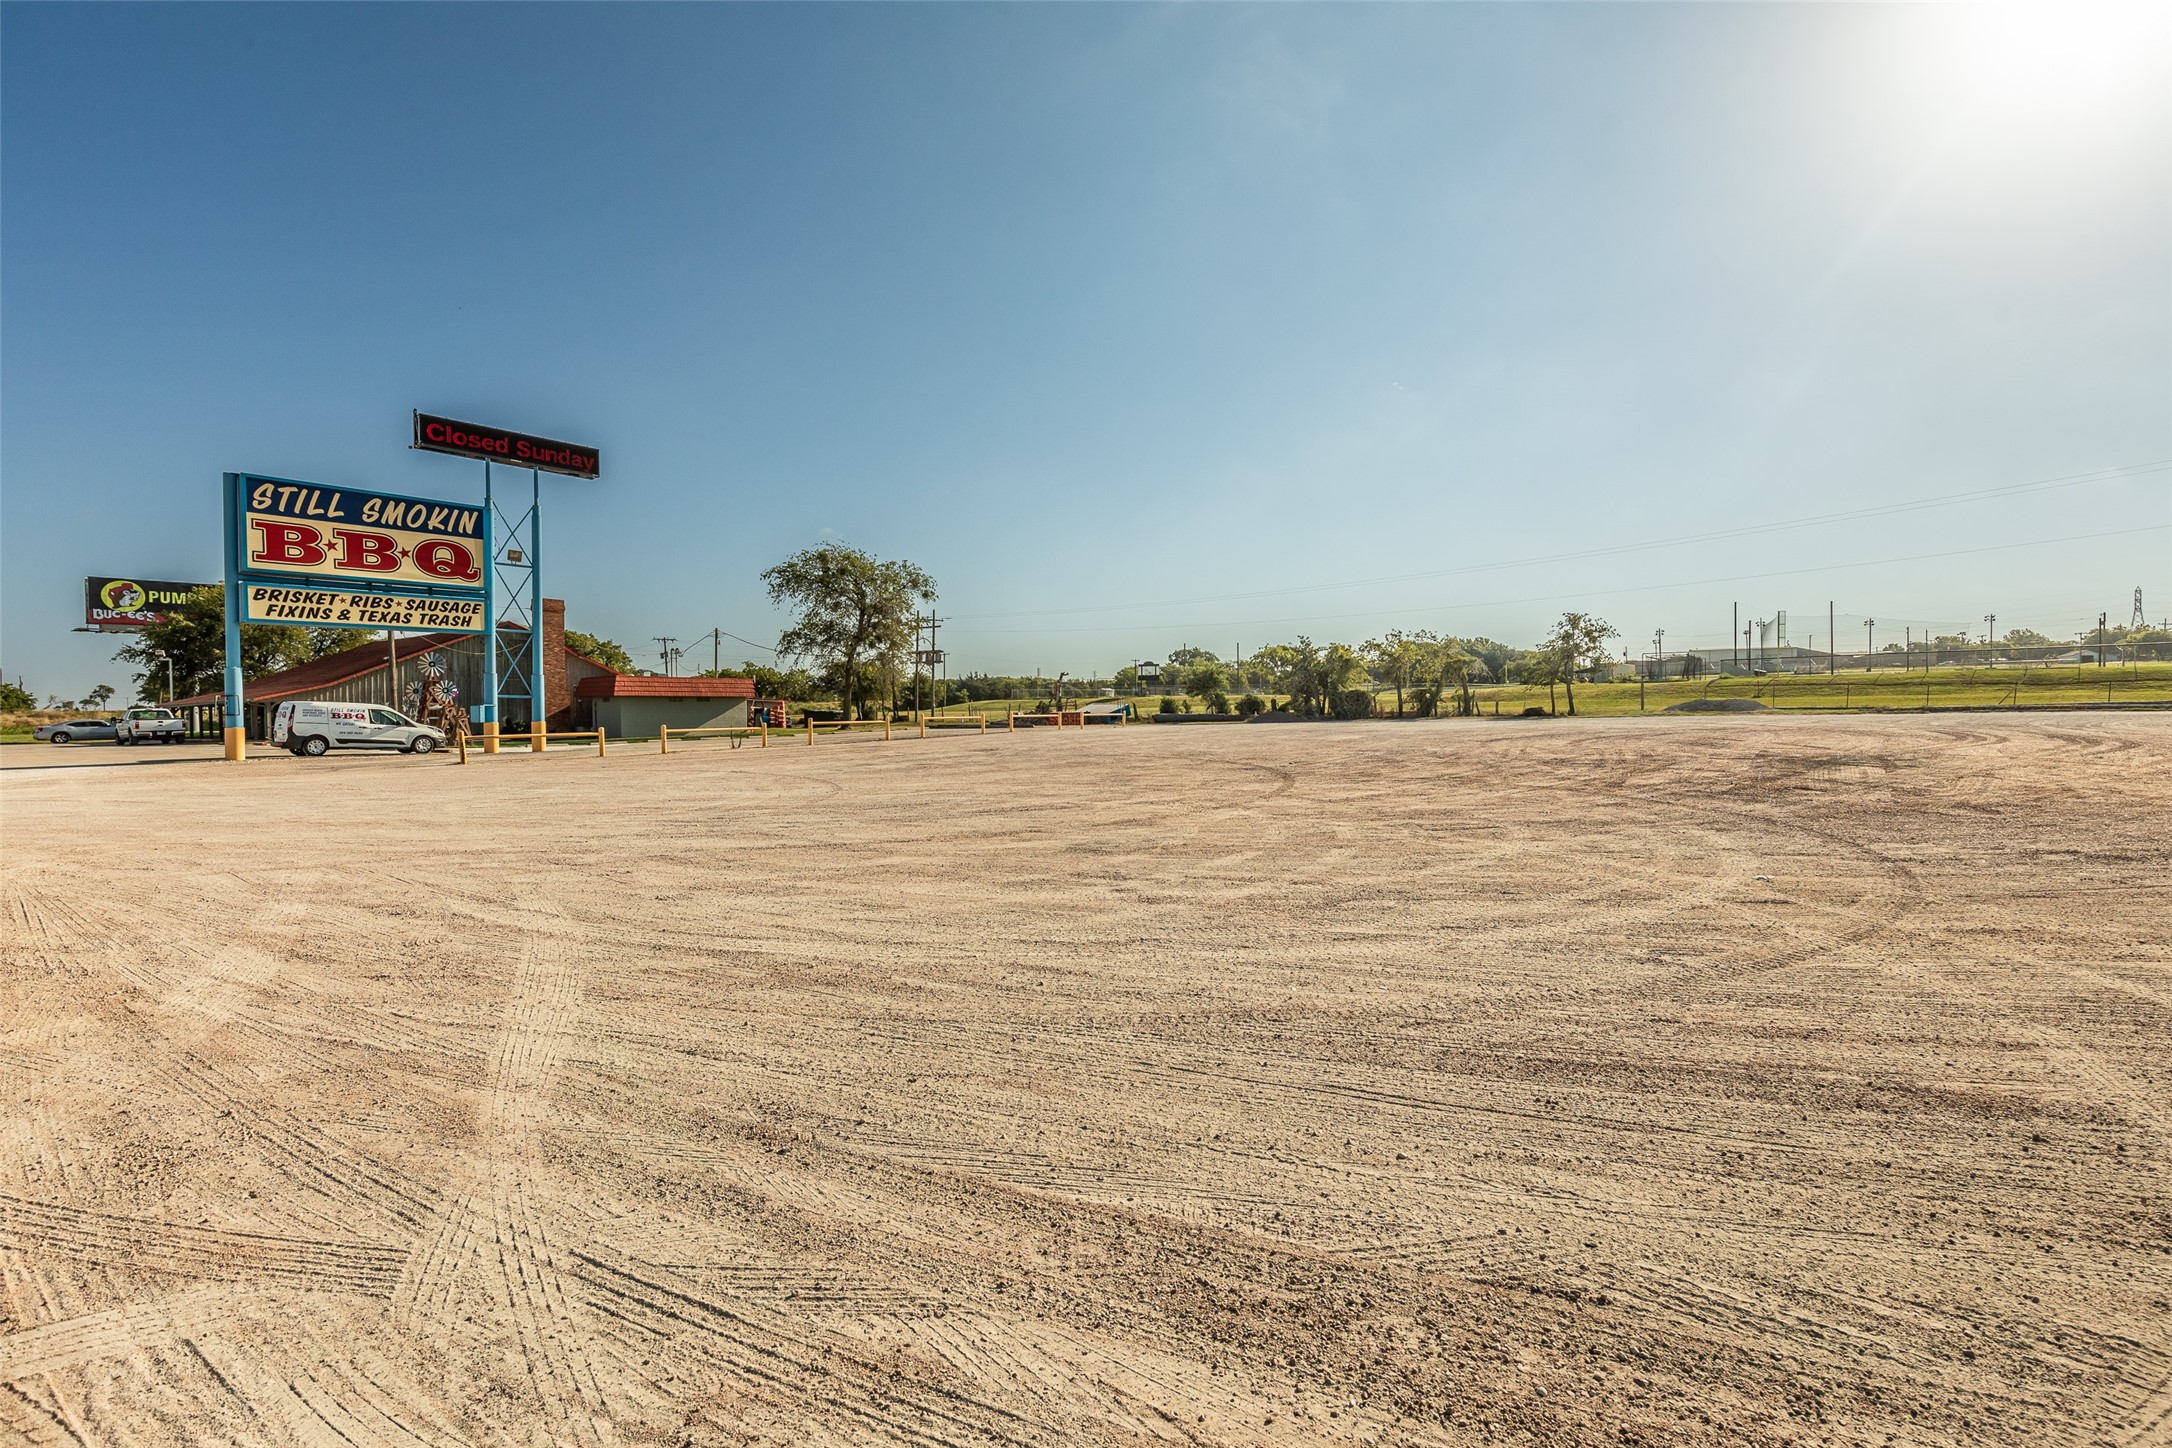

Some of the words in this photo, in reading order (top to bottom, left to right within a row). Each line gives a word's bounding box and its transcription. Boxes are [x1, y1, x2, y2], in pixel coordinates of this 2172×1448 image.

[426, 423, 508, 454] Closed
[516, 440, 595, 472] Sunday
[252, 483, 344, 518] STILL
[362, 498, 478, 534] SMOKIN
[253, 588, 339, 606] BRISKET
[349, 595, 394, 609] RIBS
[404, 599, 482, 614] SAUSAGE
[265, 604, 333, 619] FIXINS
[336, 609, 351, 621] &
[358, 610, 413, 624] TEXAS
[419, 613, 472, 627] TRASH
